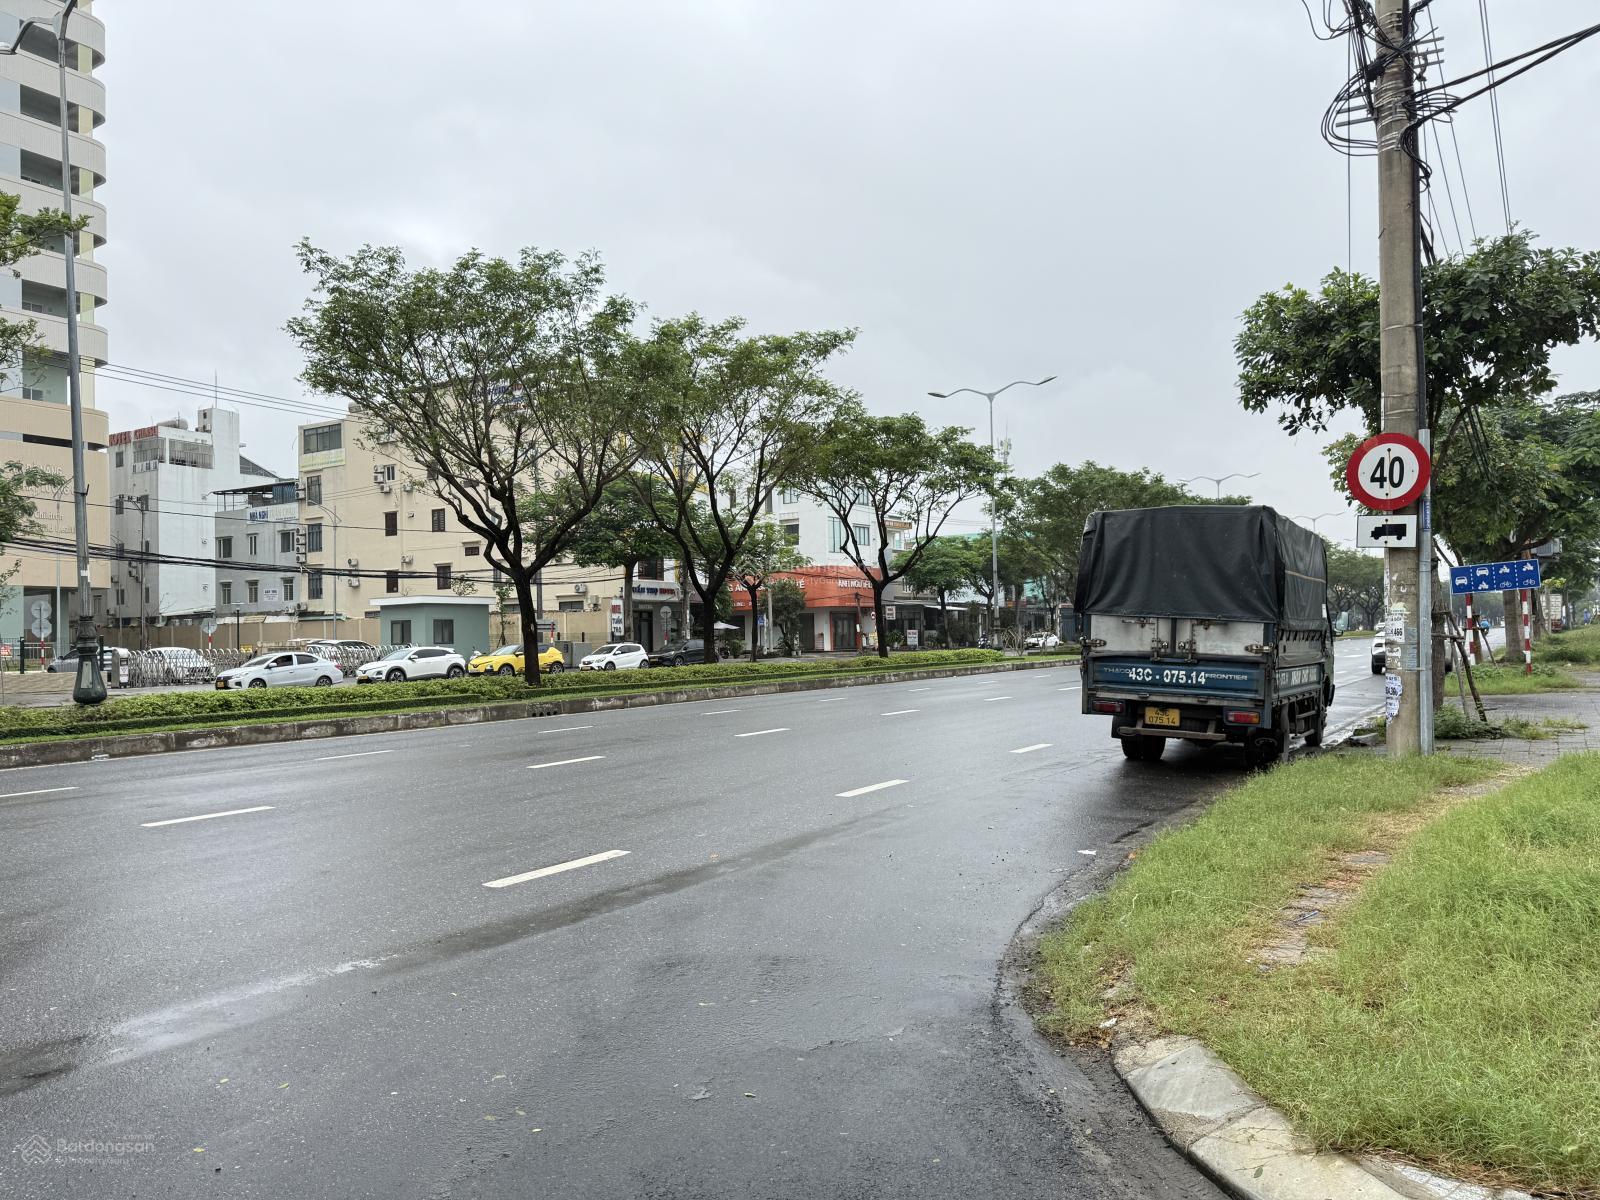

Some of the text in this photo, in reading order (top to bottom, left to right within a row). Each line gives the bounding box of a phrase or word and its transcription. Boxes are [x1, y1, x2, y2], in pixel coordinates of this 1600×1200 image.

[1370, 456, 1405, 488] 40
[1129, 667, 1153, 682] 43C
[1163, 669, 1206, 685] 075.14
[1205, 673, 1248, 681] FRONTIER
